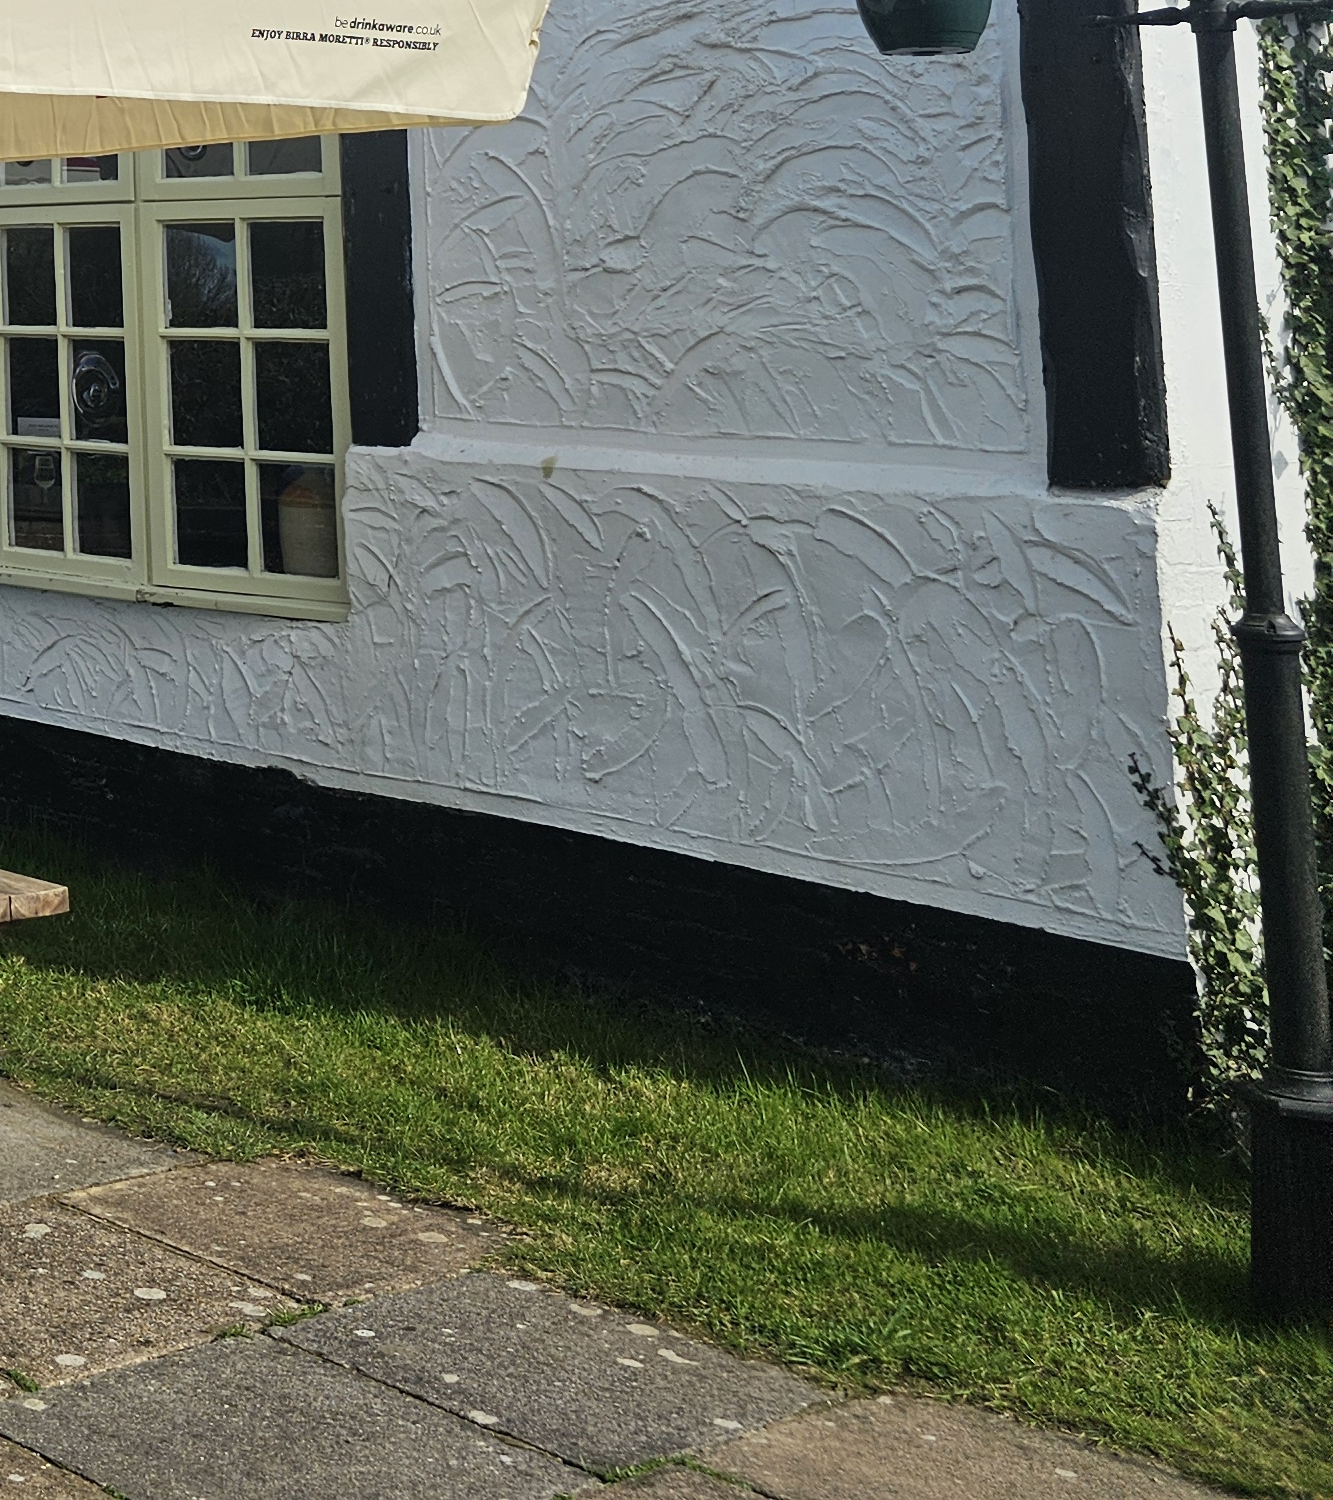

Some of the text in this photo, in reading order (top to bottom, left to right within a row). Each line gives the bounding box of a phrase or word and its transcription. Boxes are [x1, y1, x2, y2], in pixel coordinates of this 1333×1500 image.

[251, 29, 284, 41] ENJOY
[285, 30, 316, 42] BIRRA
[372, 37, 439, 51] RESPONSIBLY
